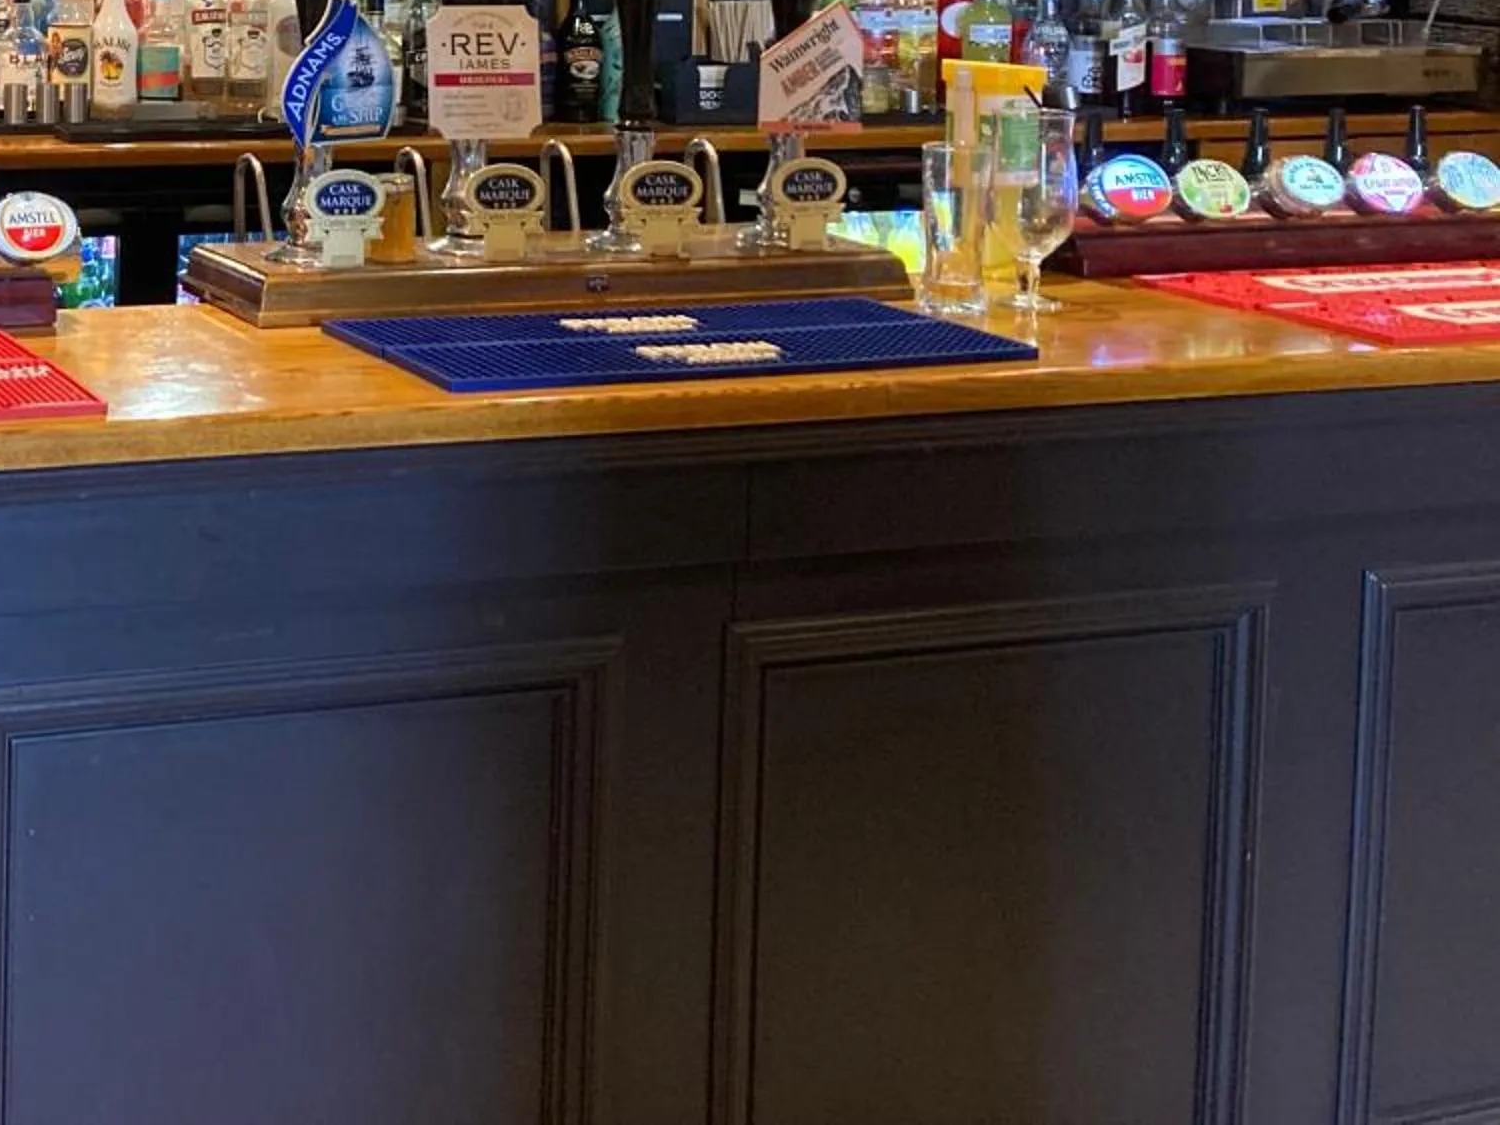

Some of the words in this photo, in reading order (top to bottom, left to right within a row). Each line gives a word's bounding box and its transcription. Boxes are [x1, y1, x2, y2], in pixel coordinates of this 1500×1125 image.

[450, 32, 520, 56] REV
[286, 32, 346, 124] ADNAMS
[329, 184, 361, 195] CASK
[320, 195, 373, 209] MARQUE
[8, 210, 58, 224] AMSTEL
